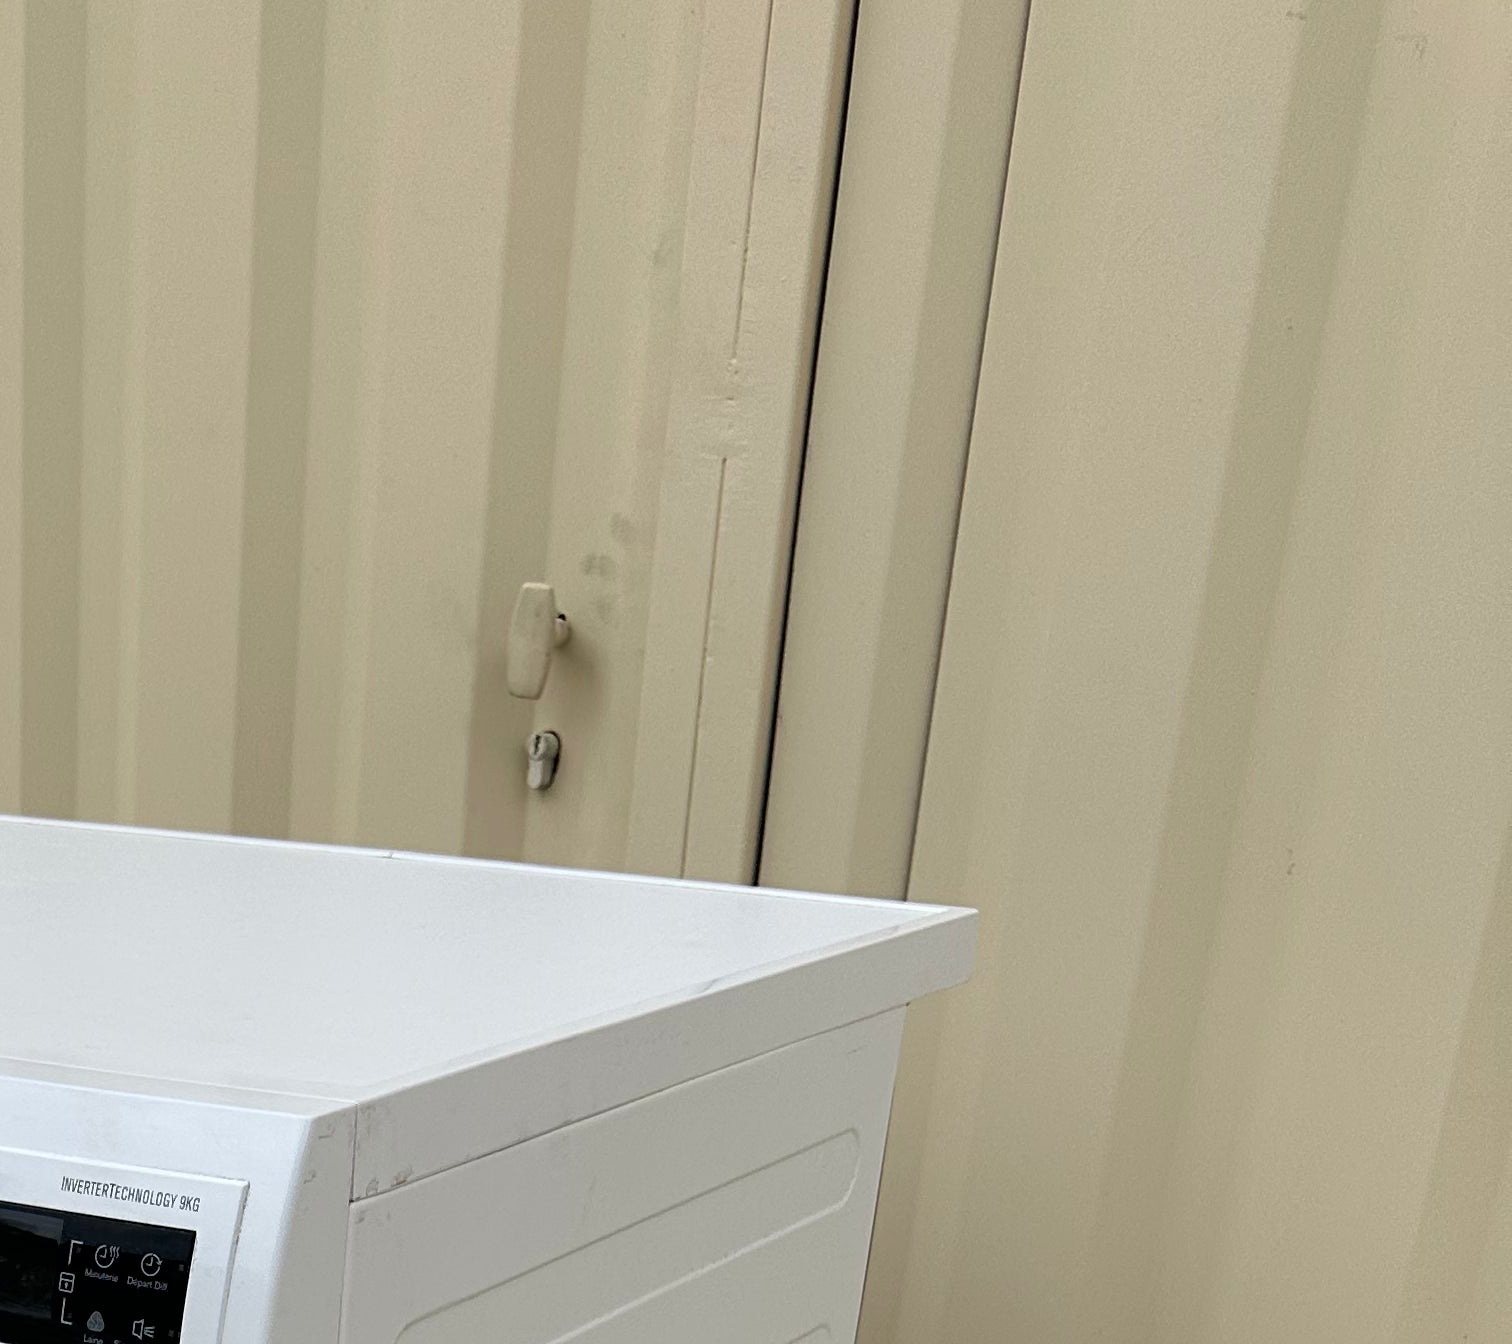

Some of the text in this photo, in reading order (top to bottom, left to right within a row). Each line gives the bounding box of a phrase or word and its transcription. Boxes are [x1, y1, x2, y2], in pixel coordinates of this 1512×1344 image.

[61, 1176, 200, 1212] INVERTERTECHNOLOGY 9KG
[127, 1275, 153, 1289] Départ
